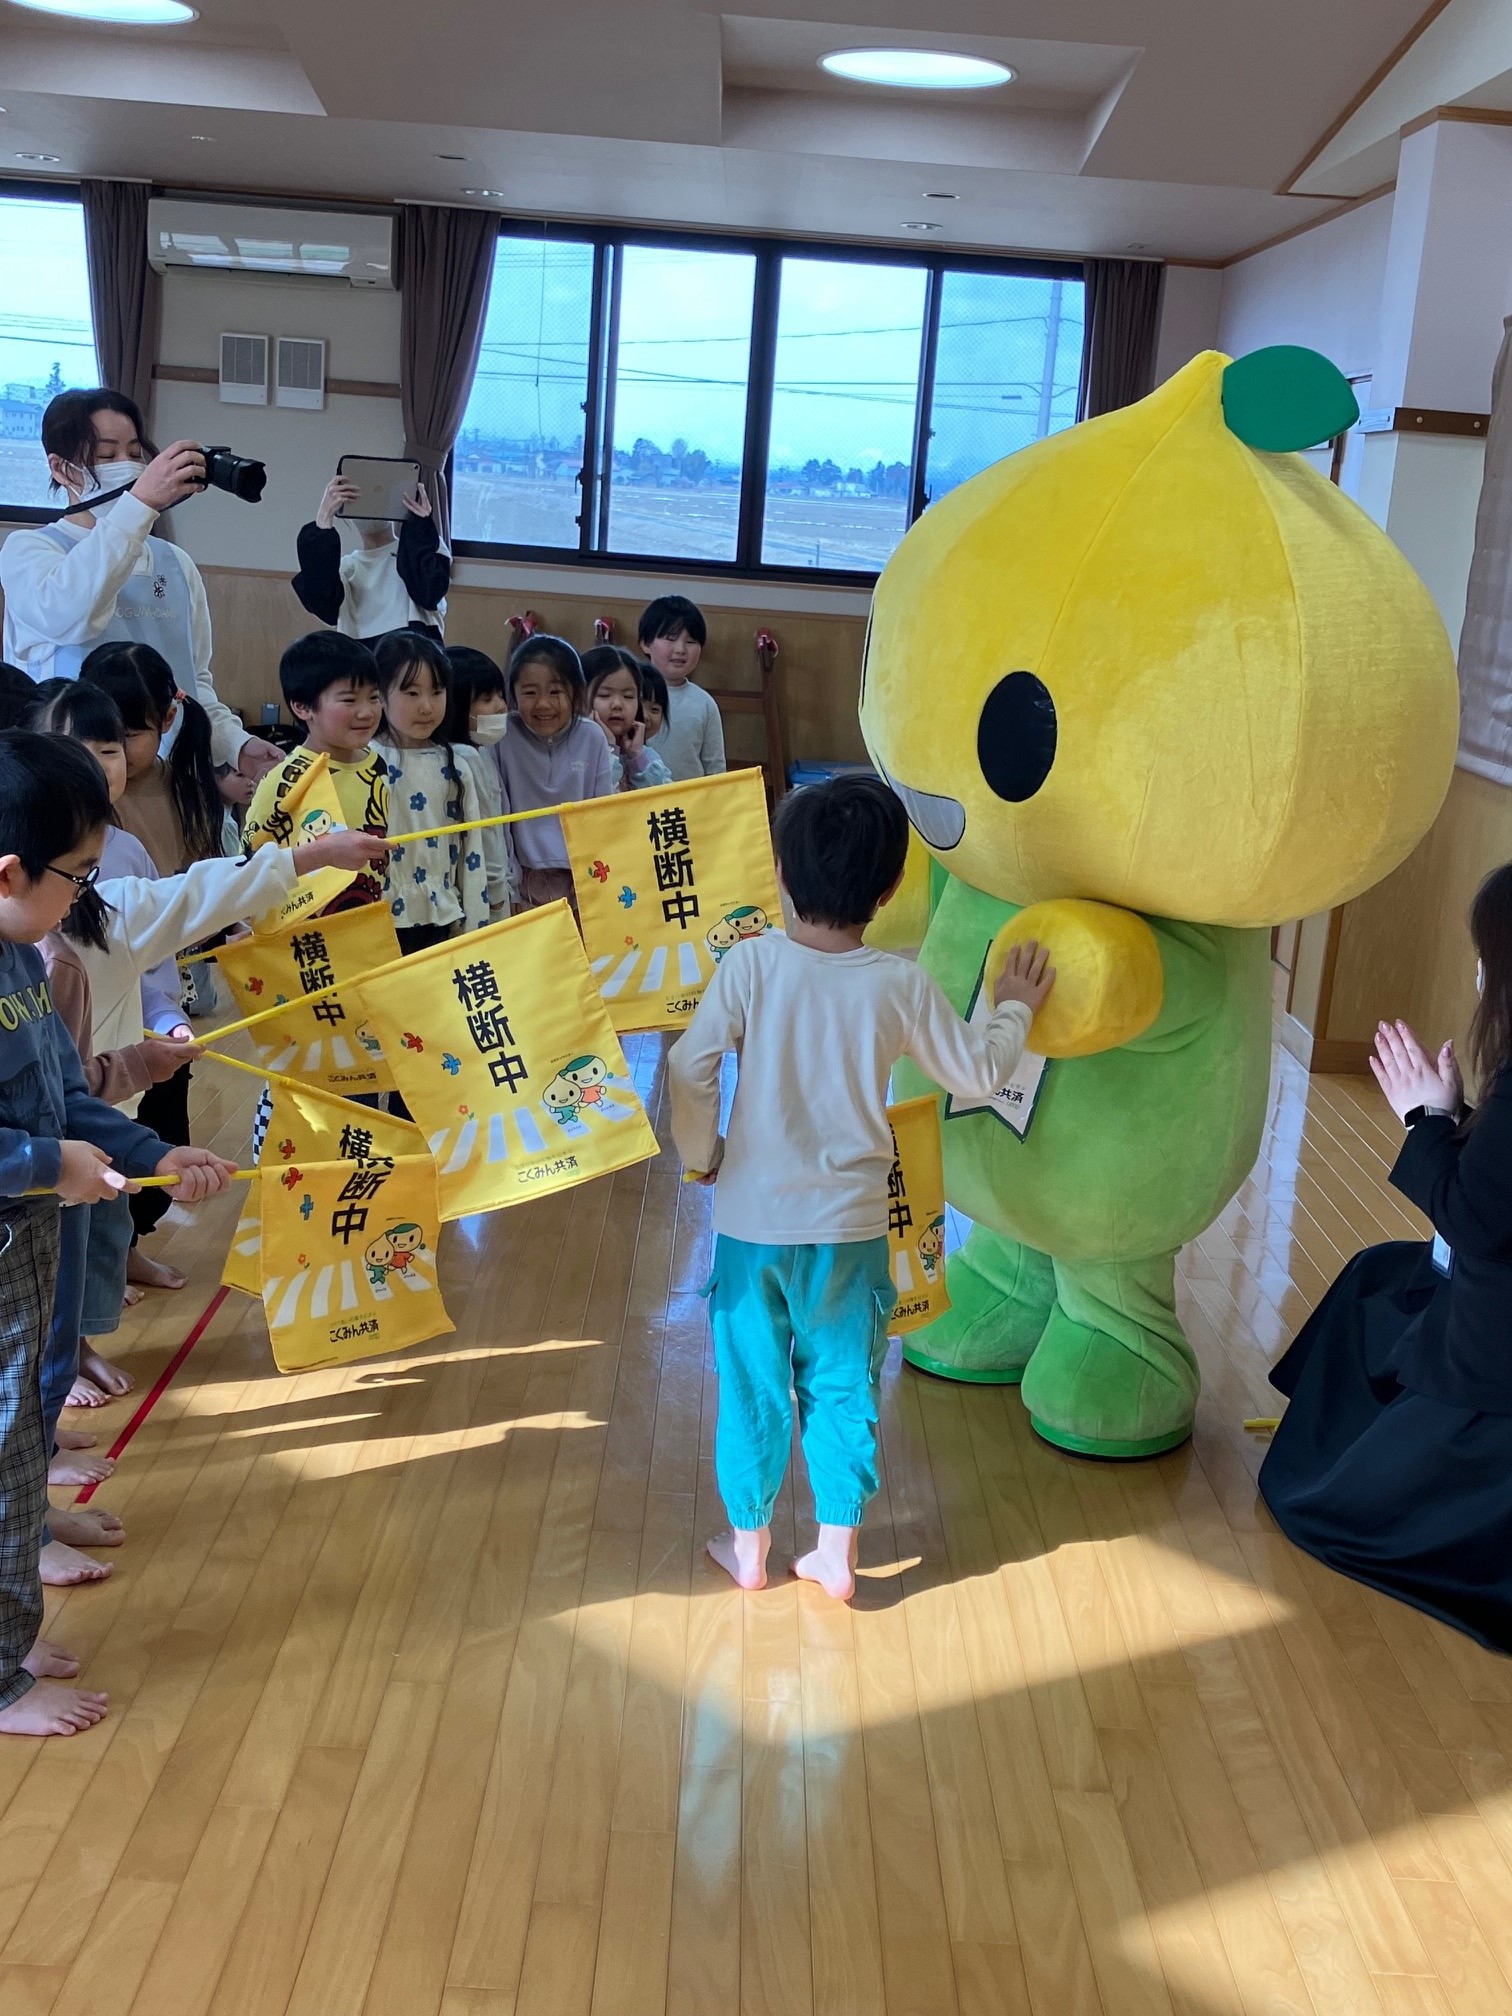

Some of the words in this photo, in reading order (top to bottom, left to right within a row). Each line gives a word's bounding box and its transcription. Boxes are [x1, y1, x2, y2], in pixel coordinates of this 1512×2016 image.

[647, 807, 700, 930] 横断中
[290, 931, 346, 1027] 横断中
[452, 960, 529, 1094] 横断中
[517, 1155, 579, 1183] こくみん共済
[329, 1318, 379, 1343] こくみん共済
